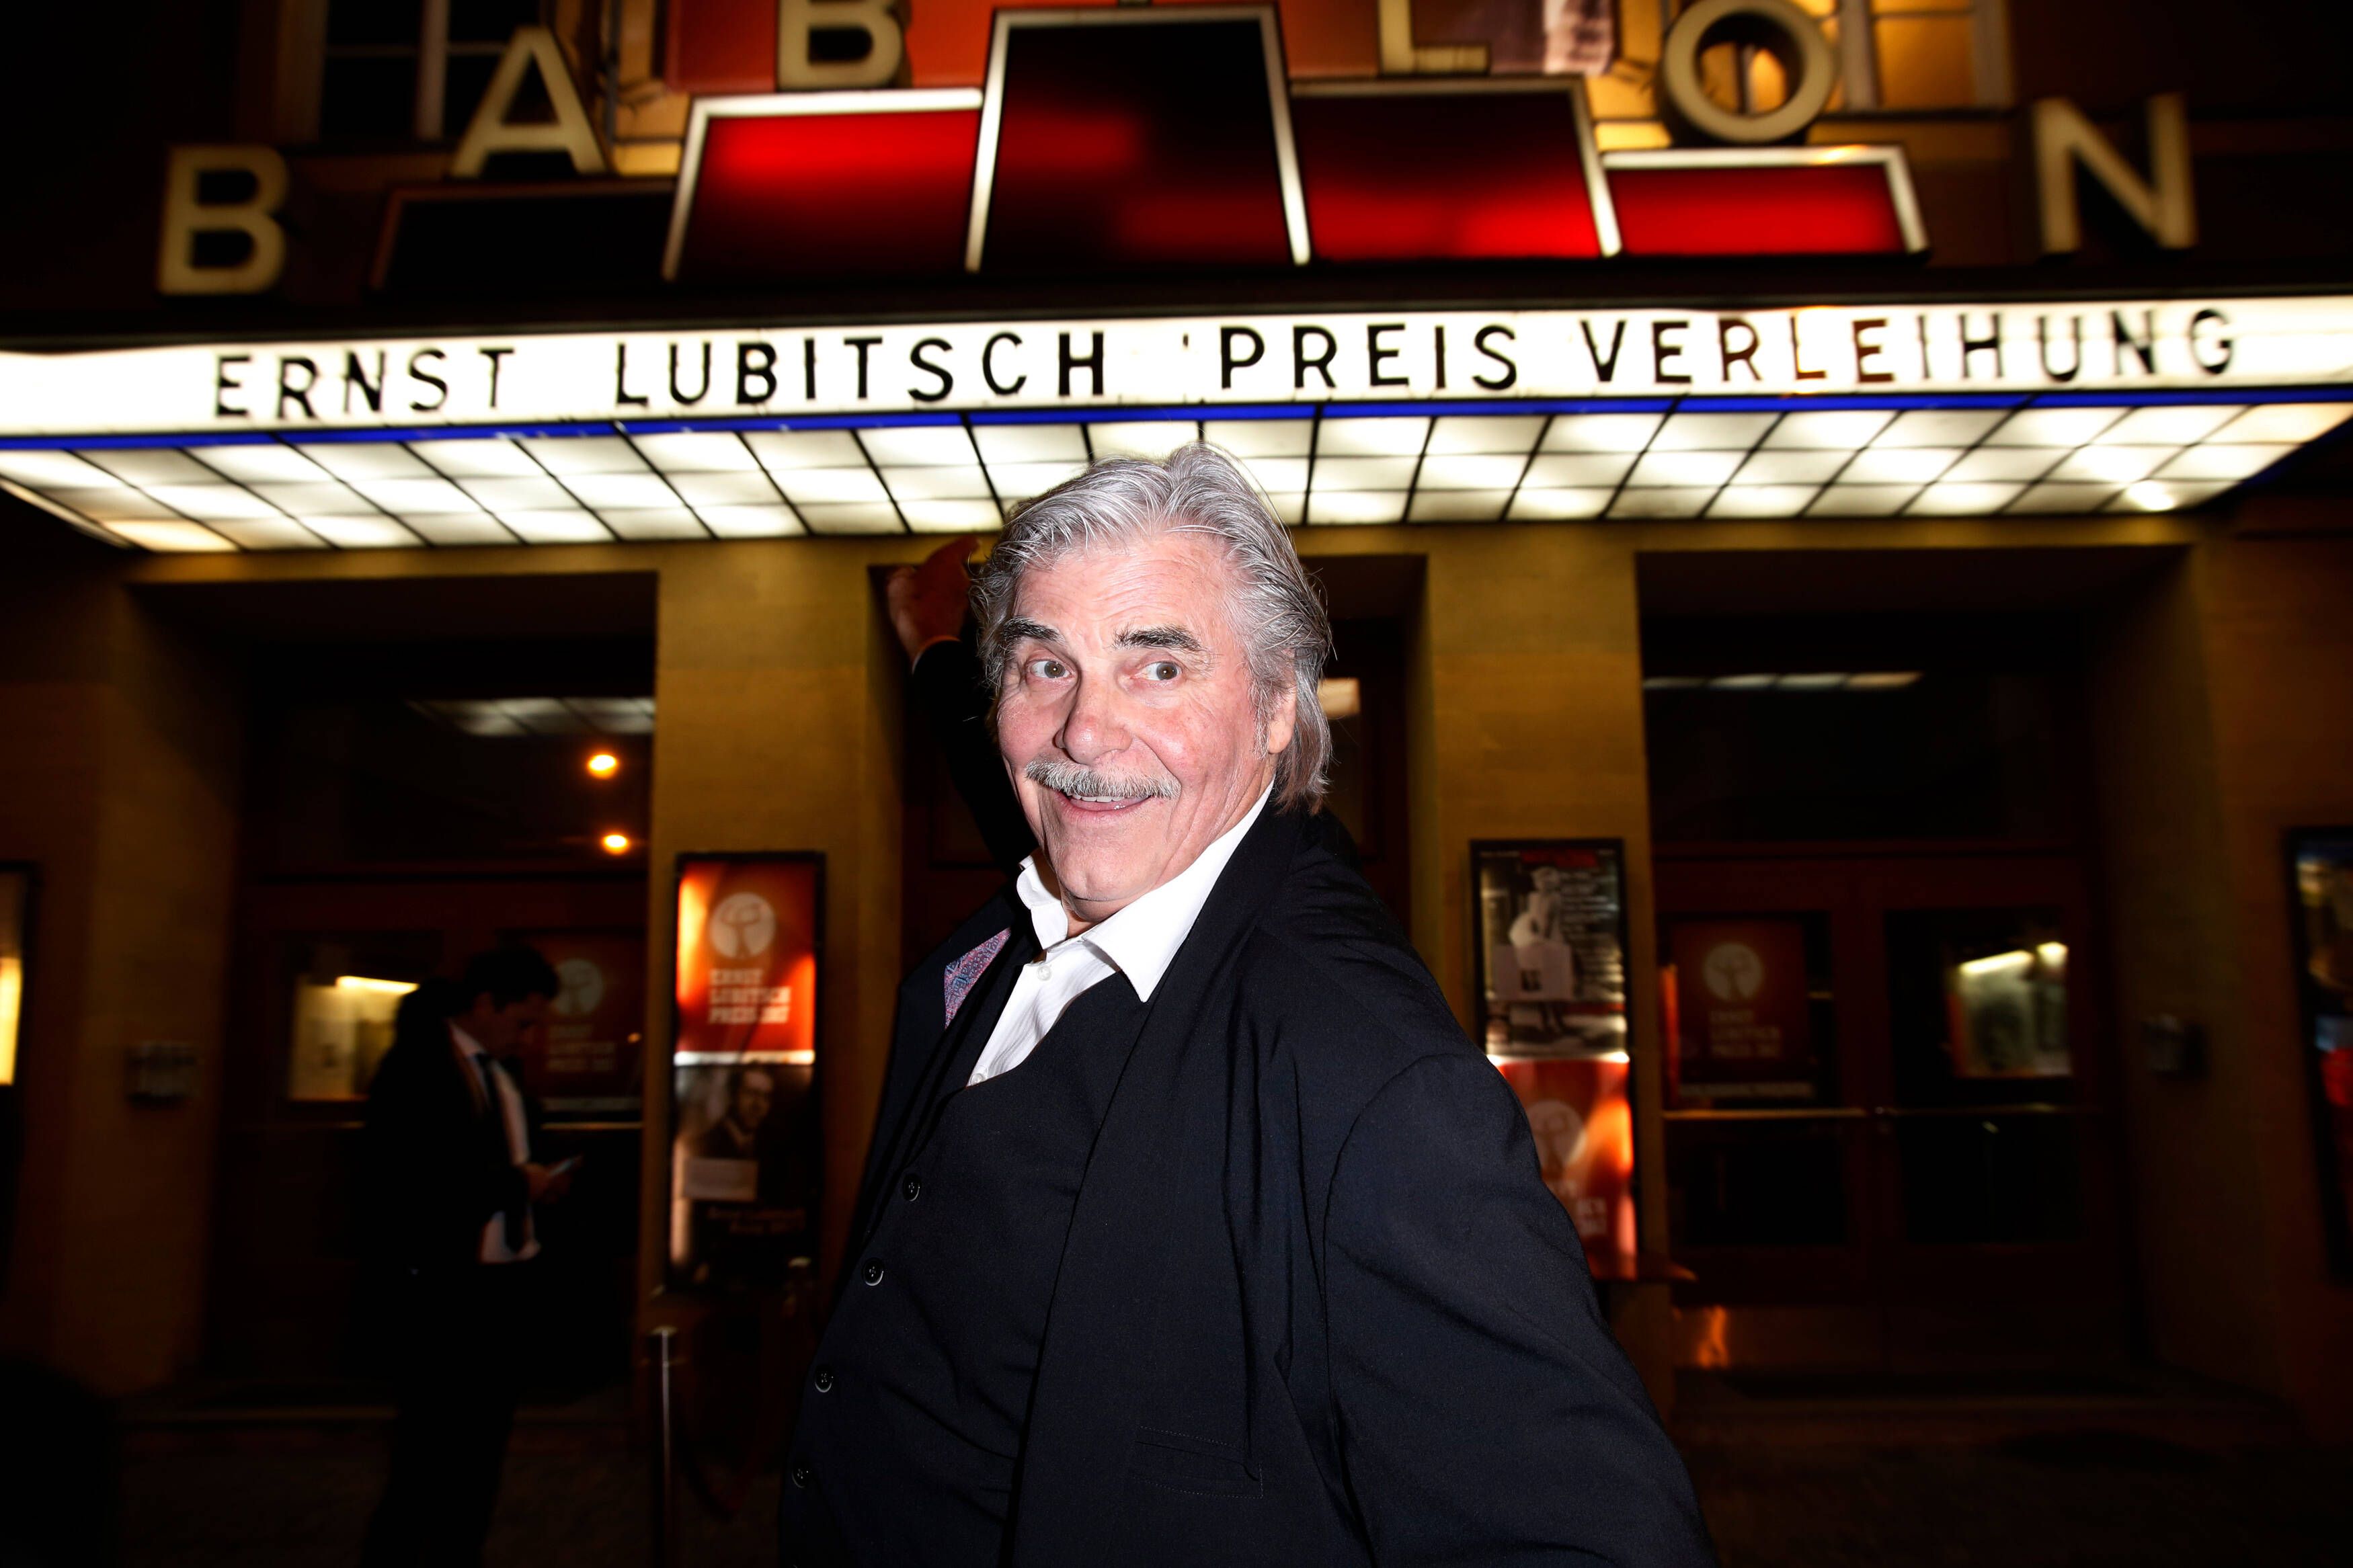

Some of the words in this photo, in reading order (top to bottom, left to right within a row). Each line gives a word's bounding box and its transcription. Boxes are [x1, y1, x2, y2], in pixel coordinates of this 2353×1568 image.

[157, 0, 2197, 296] BABLON
[214, 349, 516, 419] ERNST
[614, 331, 1105, 403] LUBITSCH
[1581, 308, 2234, 384] VERLEIHUNG
